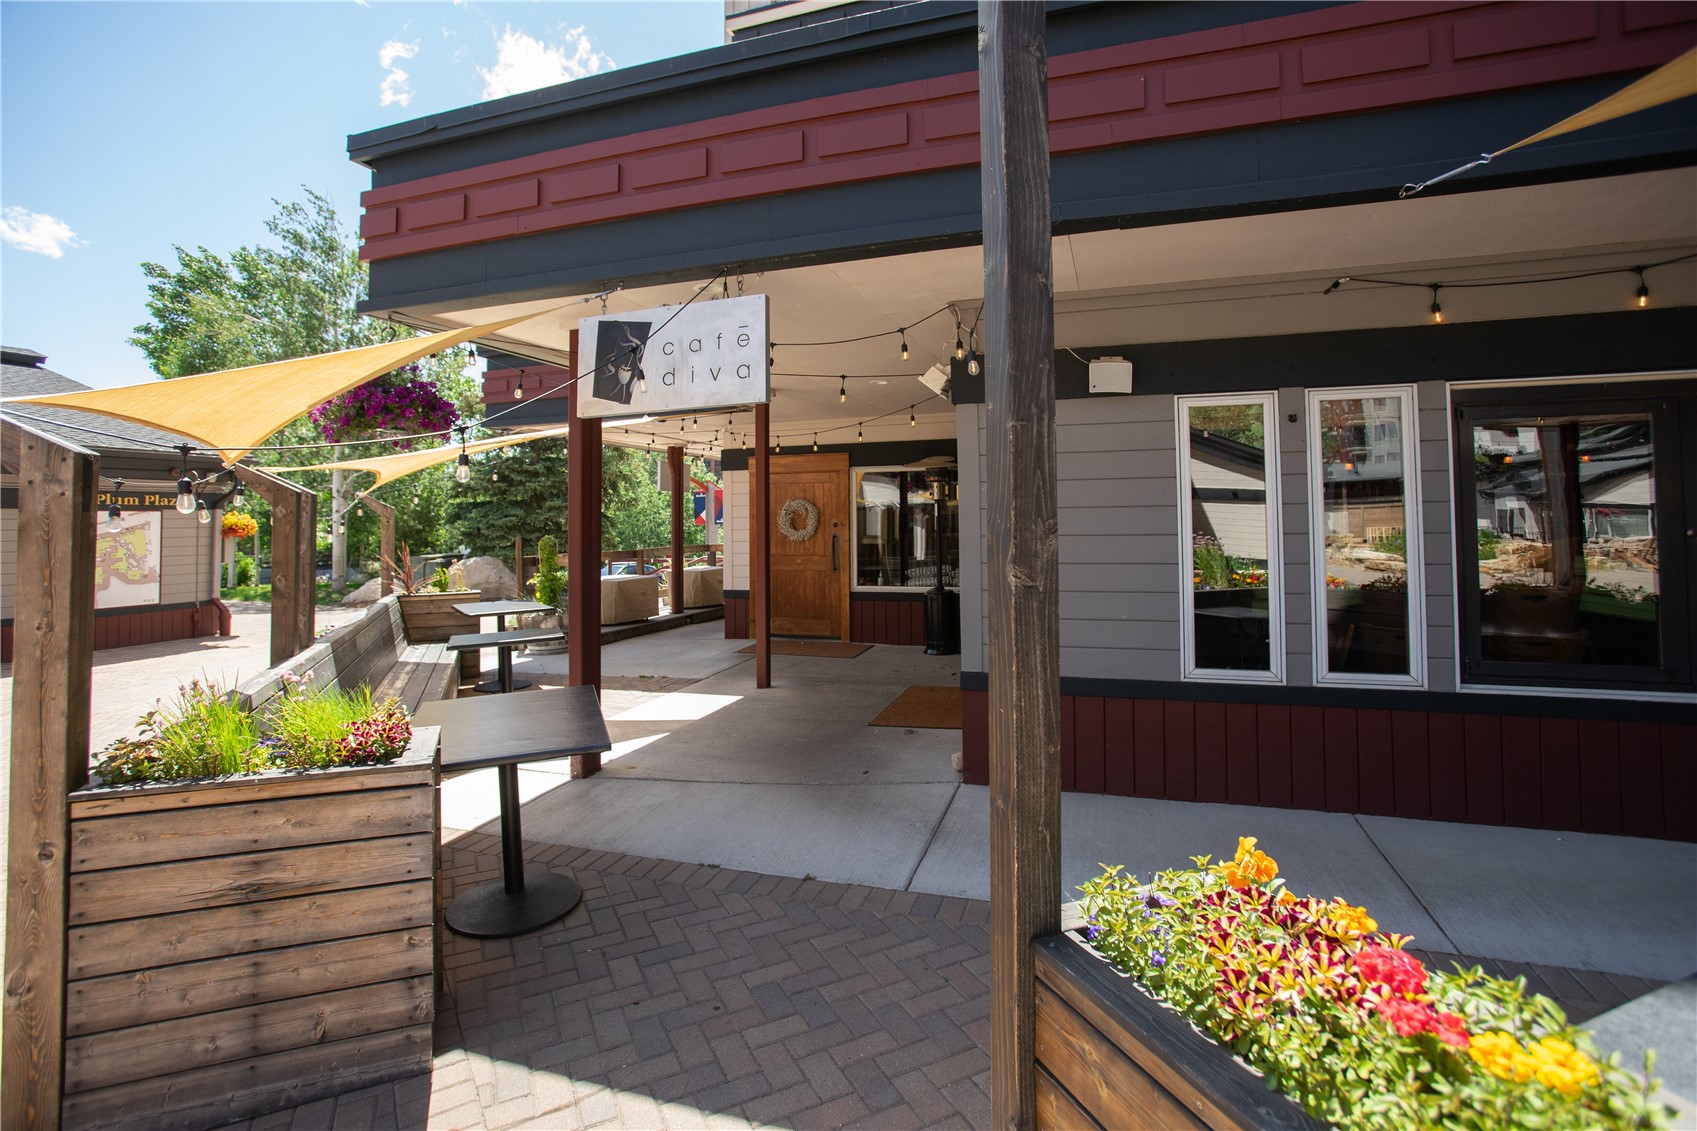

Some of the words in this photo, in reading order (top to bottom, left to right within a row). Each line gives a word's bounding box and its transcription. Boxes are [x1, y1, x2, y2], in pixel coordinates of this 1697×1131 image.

[662, 364, 750, 386] diva
[97, 493, 139, 505] Plum
[144, 494, 178, 506] Plaz
